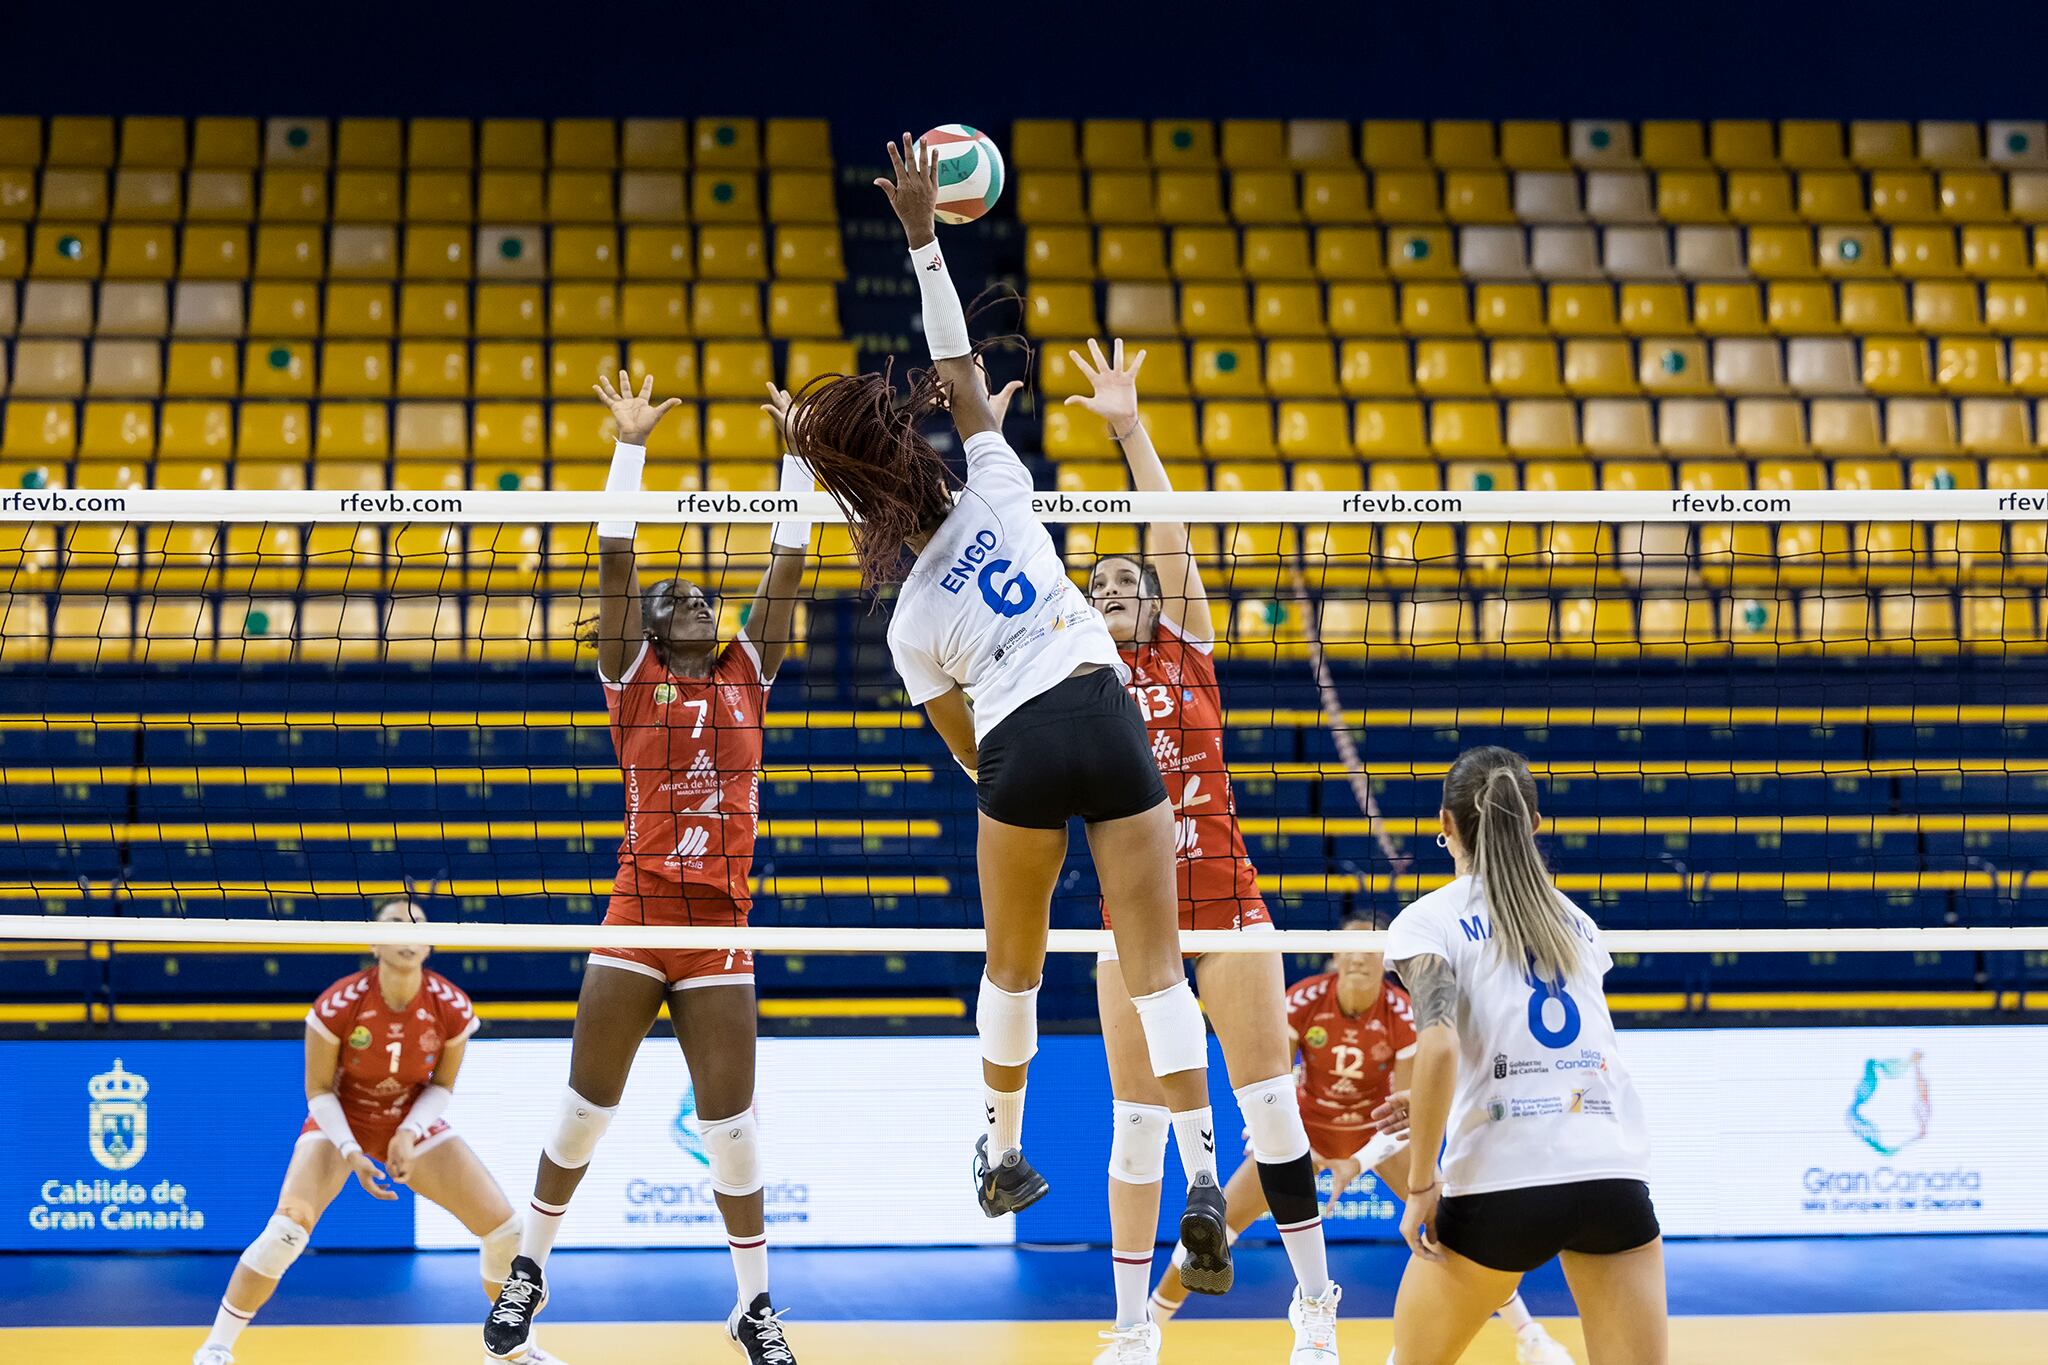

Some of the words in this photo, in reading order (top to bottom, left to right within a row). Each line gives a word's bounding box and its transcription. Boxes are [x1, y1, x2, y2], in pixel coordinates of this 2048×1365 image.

[3, 491, 125, 511] rfevb.com
[340, 491, 463, 513] rfevb.com
[677, 492, 798, 512] rfevb.com
[1032, 494, 1131, 513] evb.com
[1342, 493, 1462, 513] rfevb.com
[1672, 492, 1791, 512] rfevb.com
[2000, 492, 2048, 511] rfev
[939, 529, 997, 595] ENGO
[978, 559, 1037, 619] 6
[1128, 685, 1174, 721] 13
[683, 699, 708, 738] 7
[658, 782, 689, 792] Avarca
[691, 779, 703, 789] de
[1524, 945, 1581, 1049] 8
[385, 1041, 402, 1074] 1
[1328, 1044, 1365, 1080] 12
[41, 1179, 147, 1204] Cabildo
[151, 1179, 187, 1204] de
[626, 1178, 694, 1205] Gran
[1803, 1167, 1870, 1193] Gran
[1874, 1165, 1982, 1191] Canaria
[28, 1204, 95, 1230] Gran
[100, 1203, 205, 1230] Canaria
